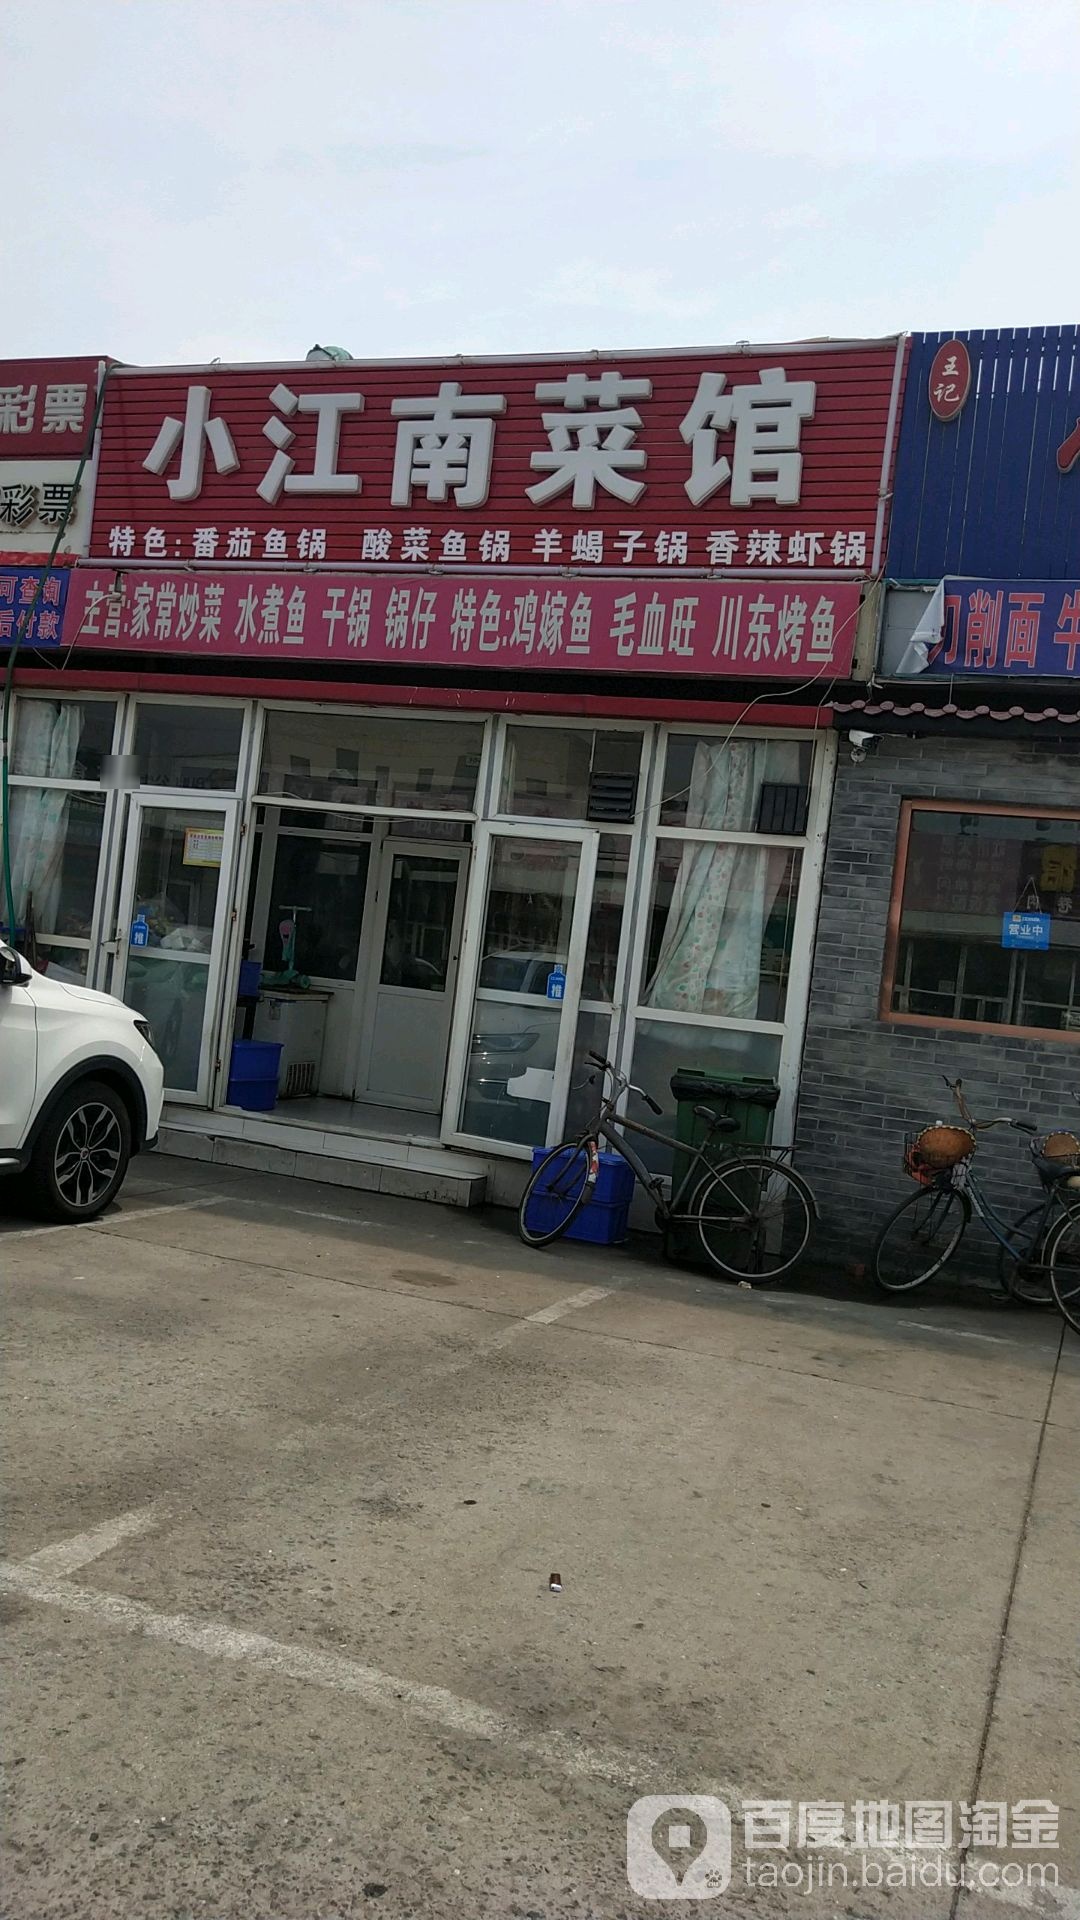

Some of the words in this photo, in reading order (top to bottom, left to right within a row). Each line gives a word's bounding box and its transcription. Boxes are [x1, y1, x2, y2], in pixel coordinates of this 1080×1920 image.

[934, 356, 959, 402] 王记
[0, 384, 87, 434] 彩票
[142, 367, 817, 510] 小江南菜馆
[0, 483, 76, 525] 彩票
[109, 525, 326, 560] 特色:番茄鱼锅
[361, 527, 511, 562] 酸菜鱼锅
[532, 528, 688, 565] 羊蝎子锅
[705, 529, 866, 566] 香辣虾锅
[234, 583, 306, 644] 水煮鱼
[322, 586, 373, 648] 干锅
[385, 586, 438, 649] 锅仔
[609, 591, 699, 657] 毛血旺
[711, 593, 835, 664] 川东烤鱼
[1008, 923, 1043, 937] 营业中
